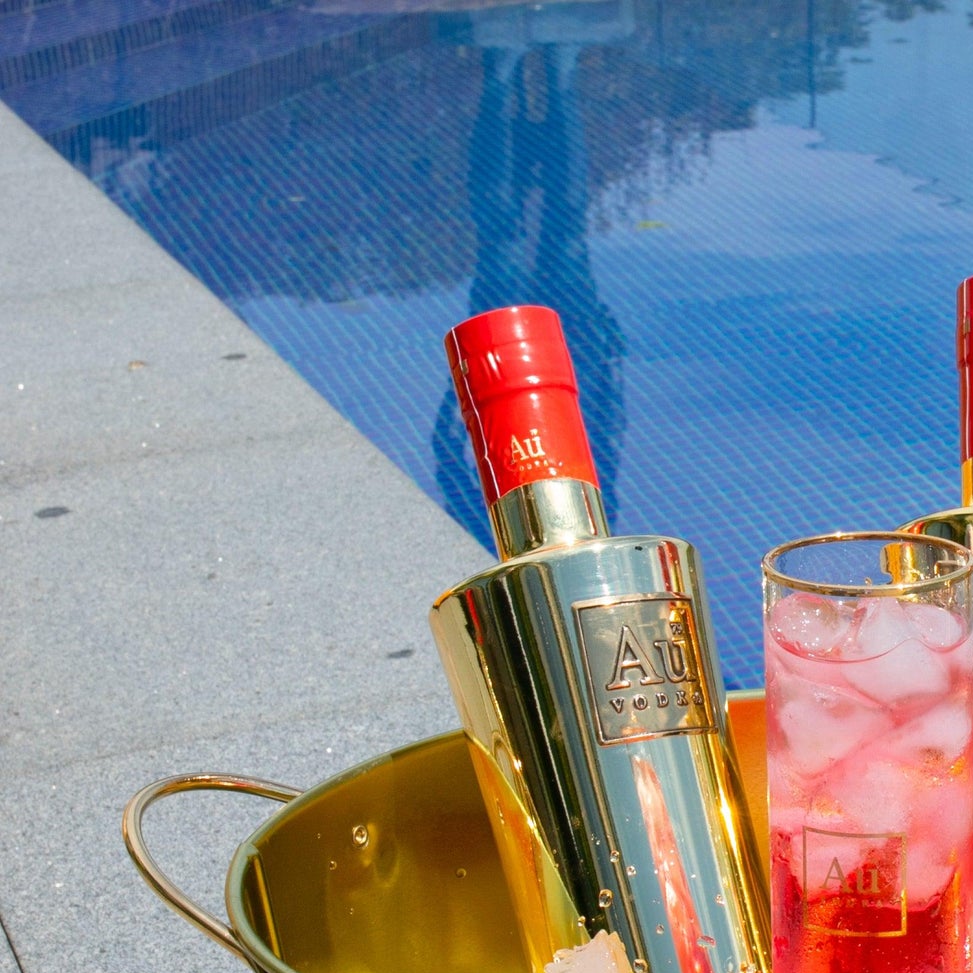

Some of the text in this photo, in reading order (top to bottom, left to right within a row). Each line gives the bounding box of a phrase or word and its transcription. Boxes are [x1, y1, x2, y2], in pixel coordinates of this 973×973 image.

[511, 434, 546, 464] Au
[605, 624, 698, 691] Au
[610, 690, 704, 714] VODKA
[818, 856, 881, 896] Au
